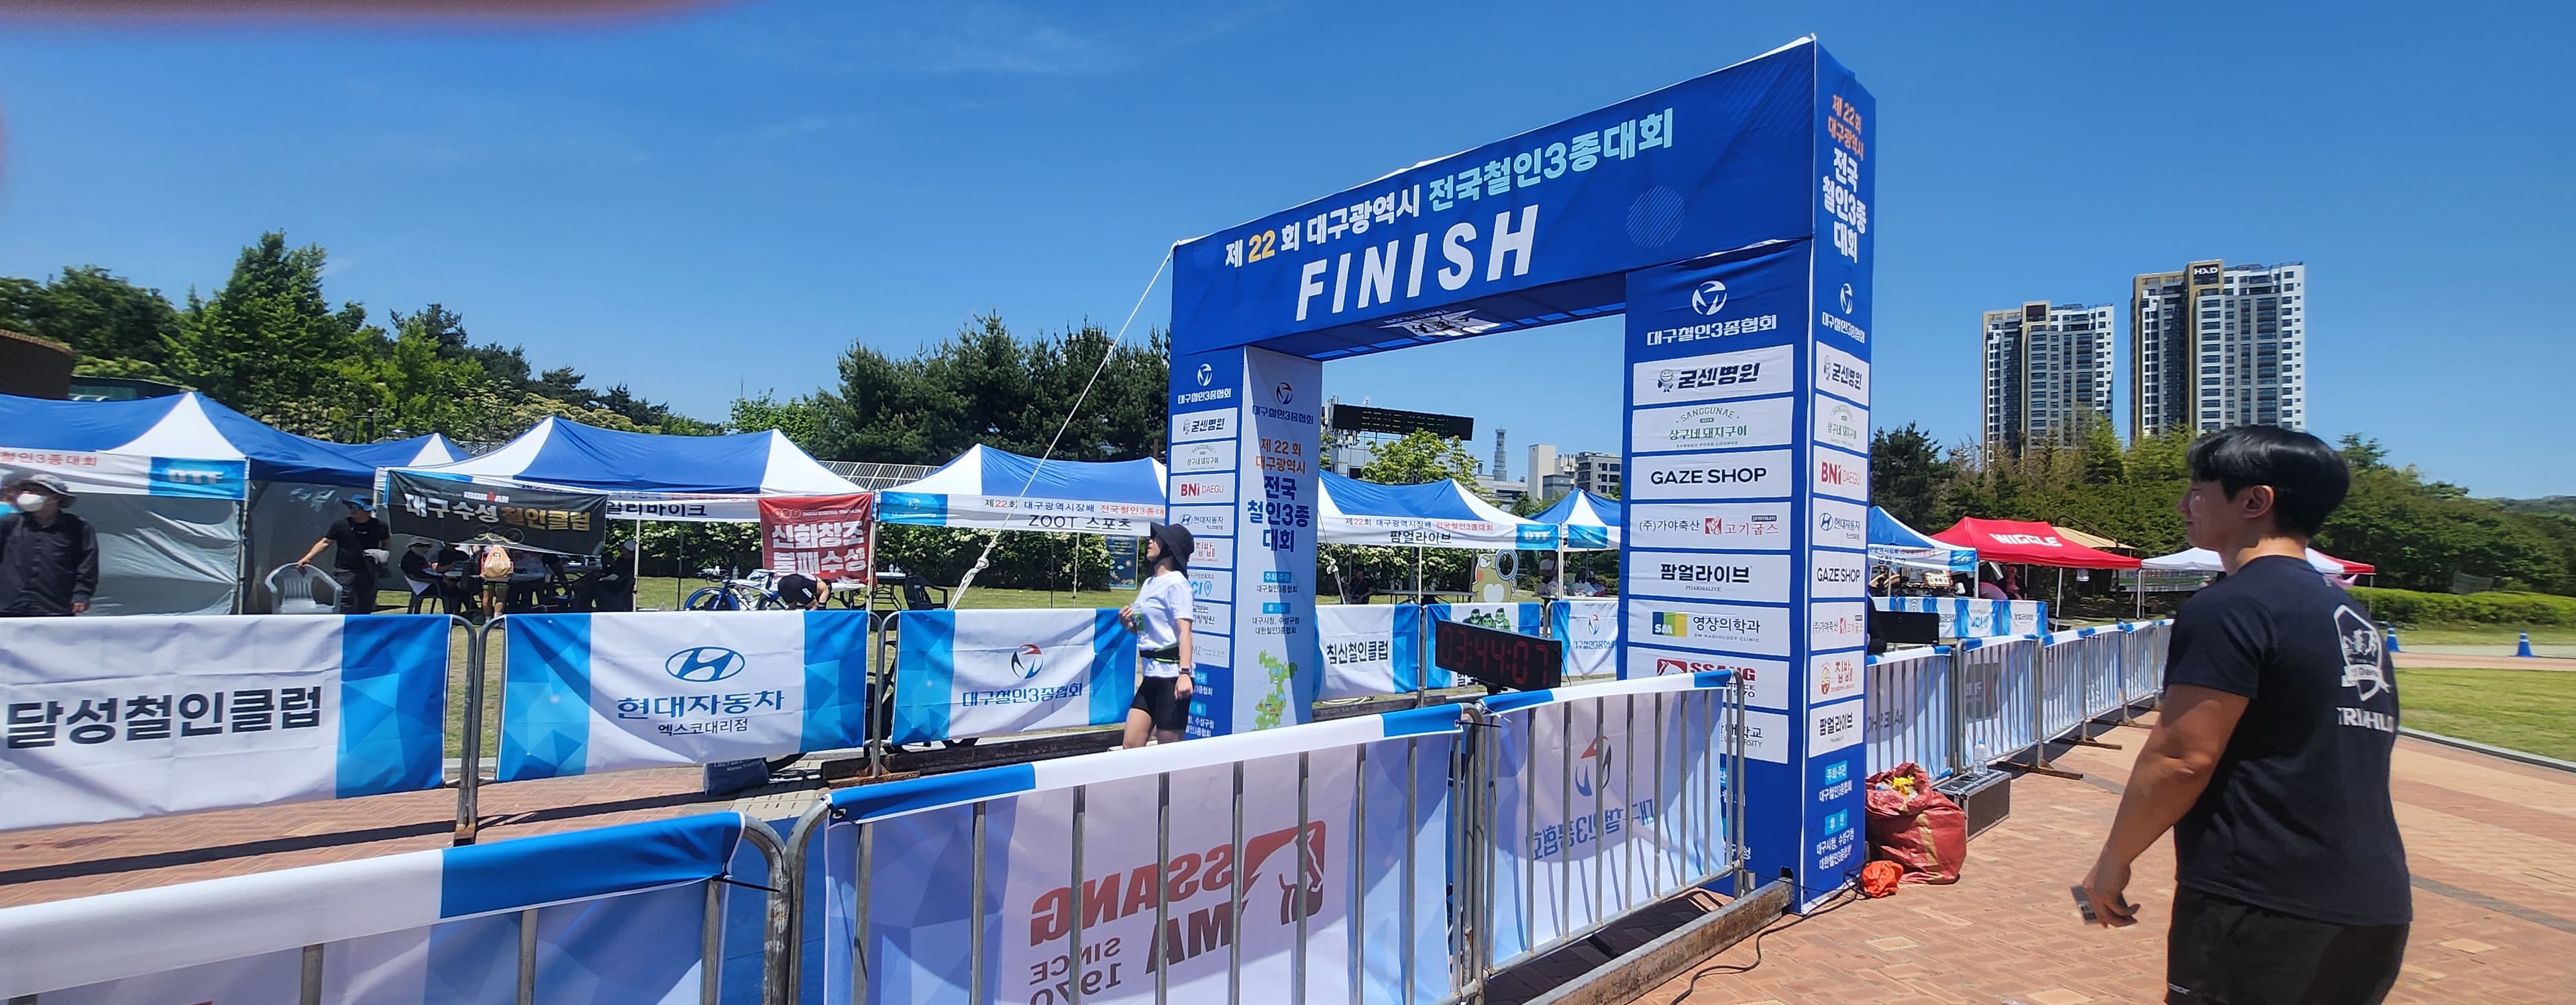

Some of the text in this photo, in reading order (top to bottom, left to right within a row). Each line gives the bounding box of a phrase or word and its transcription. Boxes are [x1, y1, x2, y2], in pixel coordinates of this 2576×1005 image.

[1828, 116, 1865, 161] 대구광역시
[1833, 148, 1858, 193] 전국
[1225, 108, 1674, 268] 제 22 회 대구광역시 전국철인3종대회
[1823, 175, 1867, 234] 철인3종
[1833, 221, 1858, 264] 대회
[1295, 205, 1540, 321] FINISH
[1646, 314, 1777, 346] 대구철인3종협회
[1821, 311, 1865, 343] 대구철인3종협회
[1677, 362, 1761, 389] 굳센병원
[1177, 387, 1232, 405] 대구철인3종협회
[1252, 405, 1313, 425] 대구철인3종협회
[1680, 407, 1735, 422] SANGGUNAE
[1261, 437, 1301, 457] 제 22 회
[1255, 455, 1306, 474] 대구광역시
[1650, 468, 1767, 485] GAZE SHOP
[1201, 483, 1224, 494] DAEGU
[1263, 475, 1297, 500] 전국
[404, 492, 591, 532] 대구수성 철인클럽
[1024, 500, 1095, 514] 대구광역시장배
[1247, 500, 1310, 528] 철인3종
[1028, 514, 1132, 531] ZOOT 스포츠
[1345, 517, 1493, 531] 제22회 대구광역시장배 전국철인3종대회
[1639, 520, 1700, 532] (주)가야축산
[1725, 523, 1779, 535] 고기굽스
[772, 521, 865, 549] 신화창조
[1262, 529, 1295, 553] 대회
[1389, 530, 1452, 544] 팜얼라이브
[1988, 533, 2063, 547] WIGGLE
[773, 547, 867, 576] 불패수성
[1660, 563, 1750, 584] 팜얼라이브
[1816, 567, 1861, 583] GAZE SHOP
[1256, 584, 1298, 594] 대구철인3종협회
[1654, 623, 1674, 634] SM
[1692, 615, 1761, 634] 영상의학과
[1704, 633, 1738, 641] RADIOLOGY
[1326, 639, 1389, 665] 침산철인클럽
[1689, 662, 1756, 682] SSG
[962, 682, 1083, 707] 대구철인3종협회
[616, 690, 785, 720] 현대자동차
[6, 685, 322, 750] 달성철인클럽
[657, 719, 748, 737] 엑스코대리점
